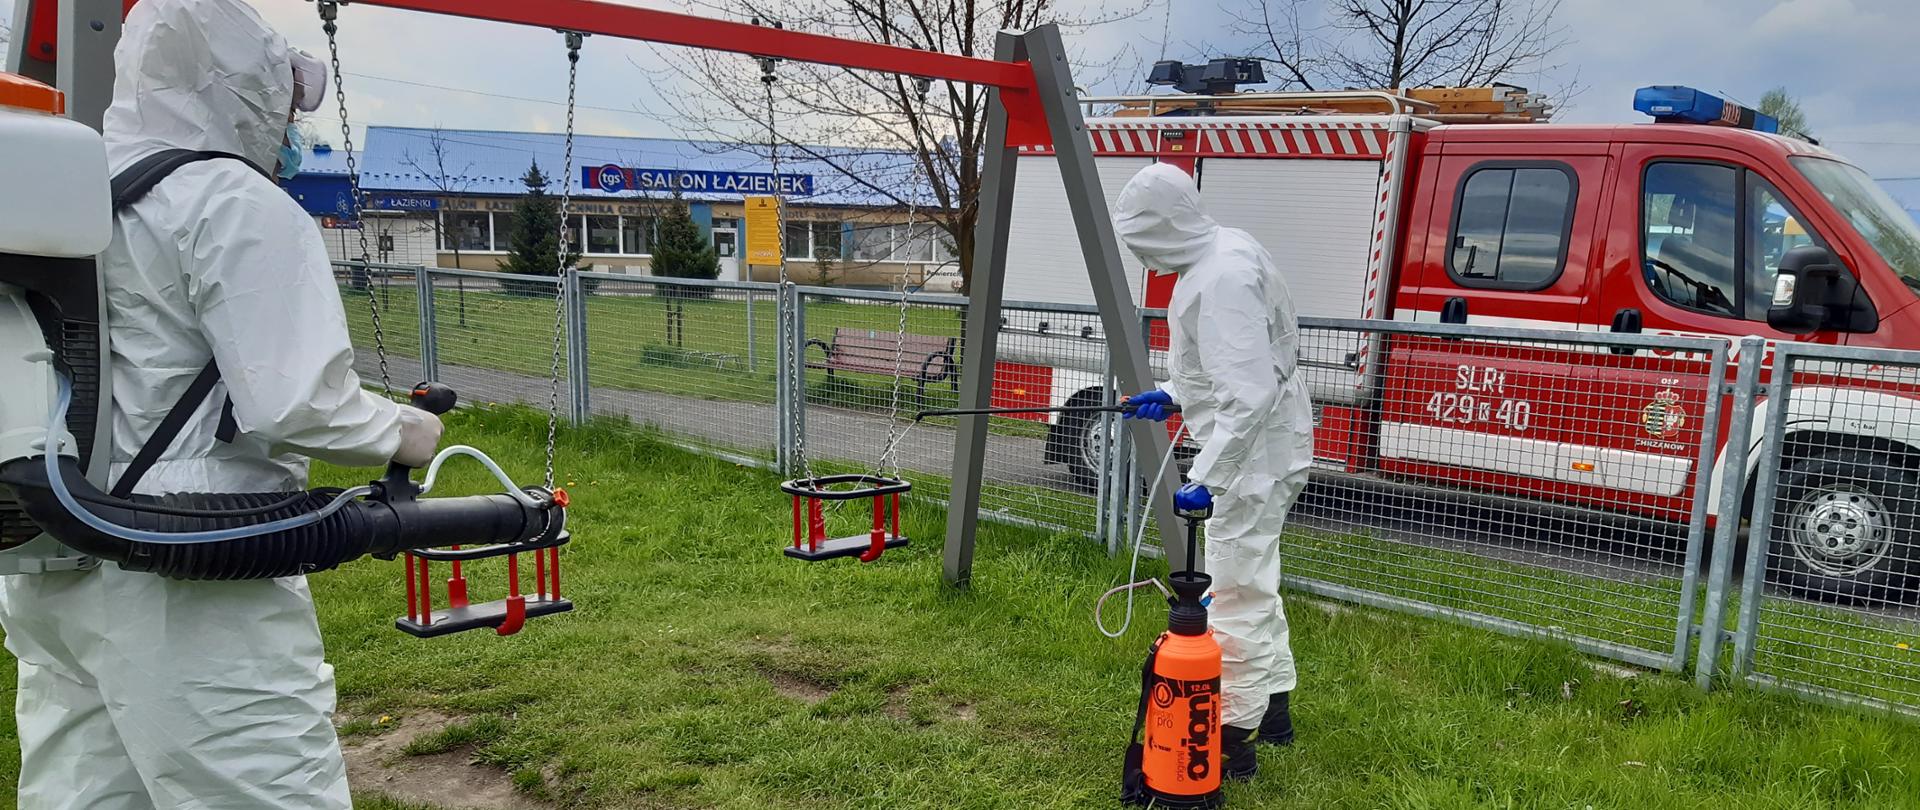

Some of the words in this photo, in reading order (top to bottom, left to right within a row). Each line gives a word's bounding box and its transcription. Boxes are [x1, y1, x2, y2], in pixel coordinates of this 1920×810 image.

[602, 173, 621, 186] tgs
[641, 172, 707, 190] SALON
[713, 175, 805, 193] ŁAZIENEK
[390, 198, 431, 208] ŁAZIENKI
[1456, 364, 1506, 393] SLRt
[1426, 392, 1474, 423] 429
[1496, 399, 1531, 430] 40
[1157, 717, 1173, 728] pro
[1181, 695, 1209, 781] orion
